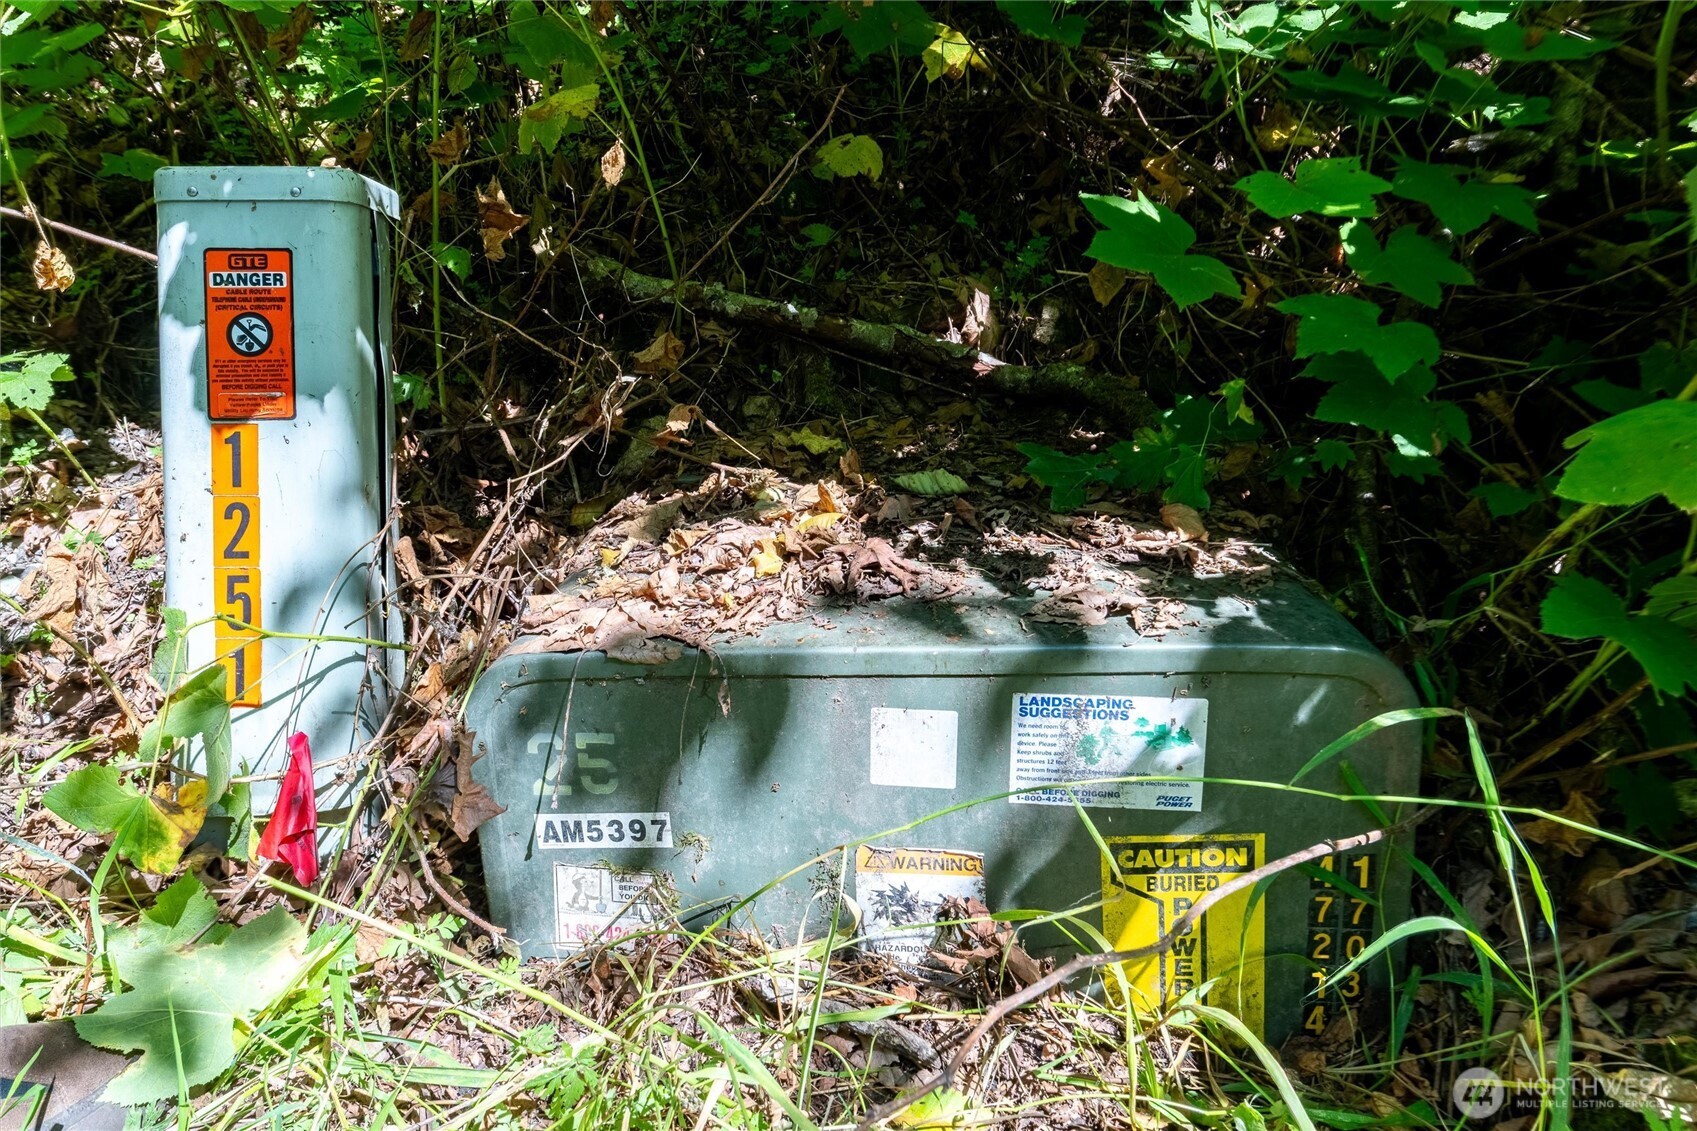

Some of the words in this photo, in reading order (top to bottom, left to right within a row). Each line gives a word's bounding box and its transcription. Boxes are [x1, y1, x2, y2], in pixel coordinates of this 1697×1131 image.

[229, 255, 267, 268] GTE
[212, 272, 284, 287] DANGER
[1019, 696, 1134, 710] LANDSCAPING
[1018, 707, 1130, 721] SUGGESTIONS
[527, 733, 619, 795] 25
[1015, 794, 1092, 804] 1-800-424-555
[1041, 788, 1079, 796] BEFOE
[1081, 789, 1120, 799] DIGGING
[542, 819, 667, 844] AM5397
[892, 856, 978, 871] WARNING
[1117, 847, 1248, 868] CAUTION
[1146, 875, 1220, 892] BURIED
[875, 944, 927, 953] HAZARDOU
